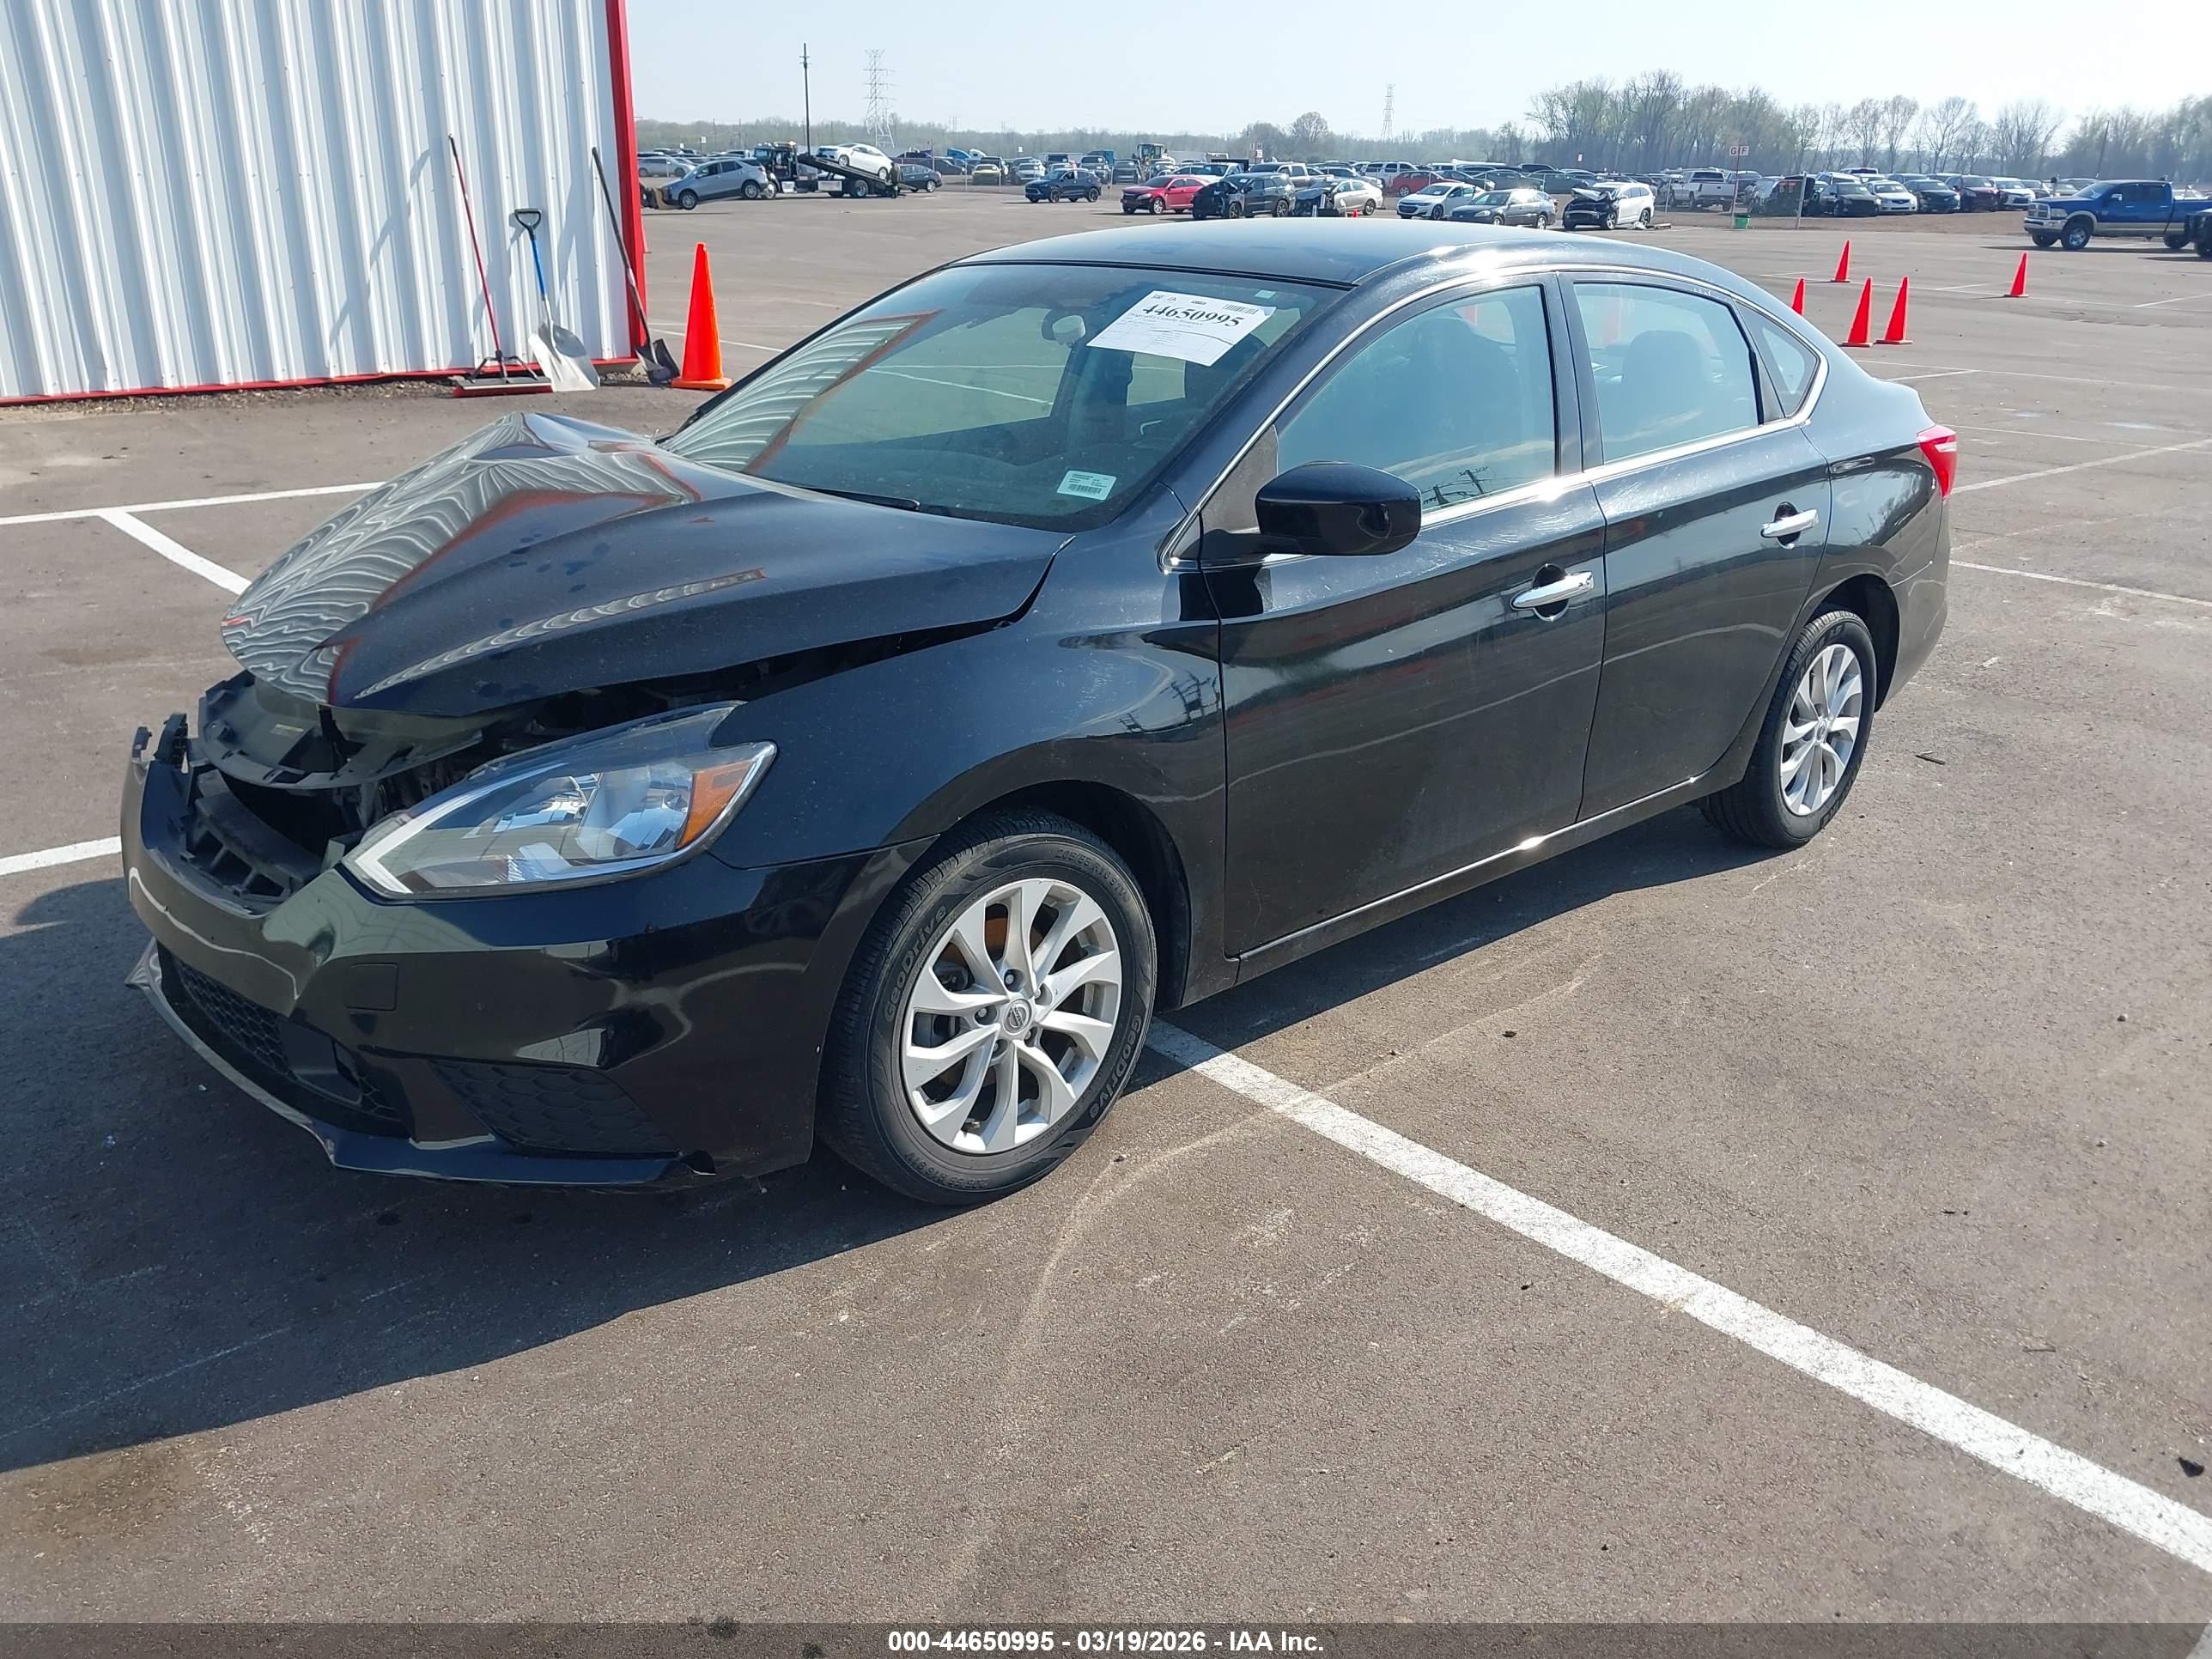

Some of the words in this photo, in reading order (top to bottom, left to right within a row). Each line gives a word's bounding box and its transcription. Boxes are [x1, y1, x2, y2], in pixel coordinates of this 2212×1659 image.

[1142, 304, 1245, 327] 44650995
[884, 906, 946, 1023] GeoDrive
[1089, 1015, 1142, 1119] GeoDrive
